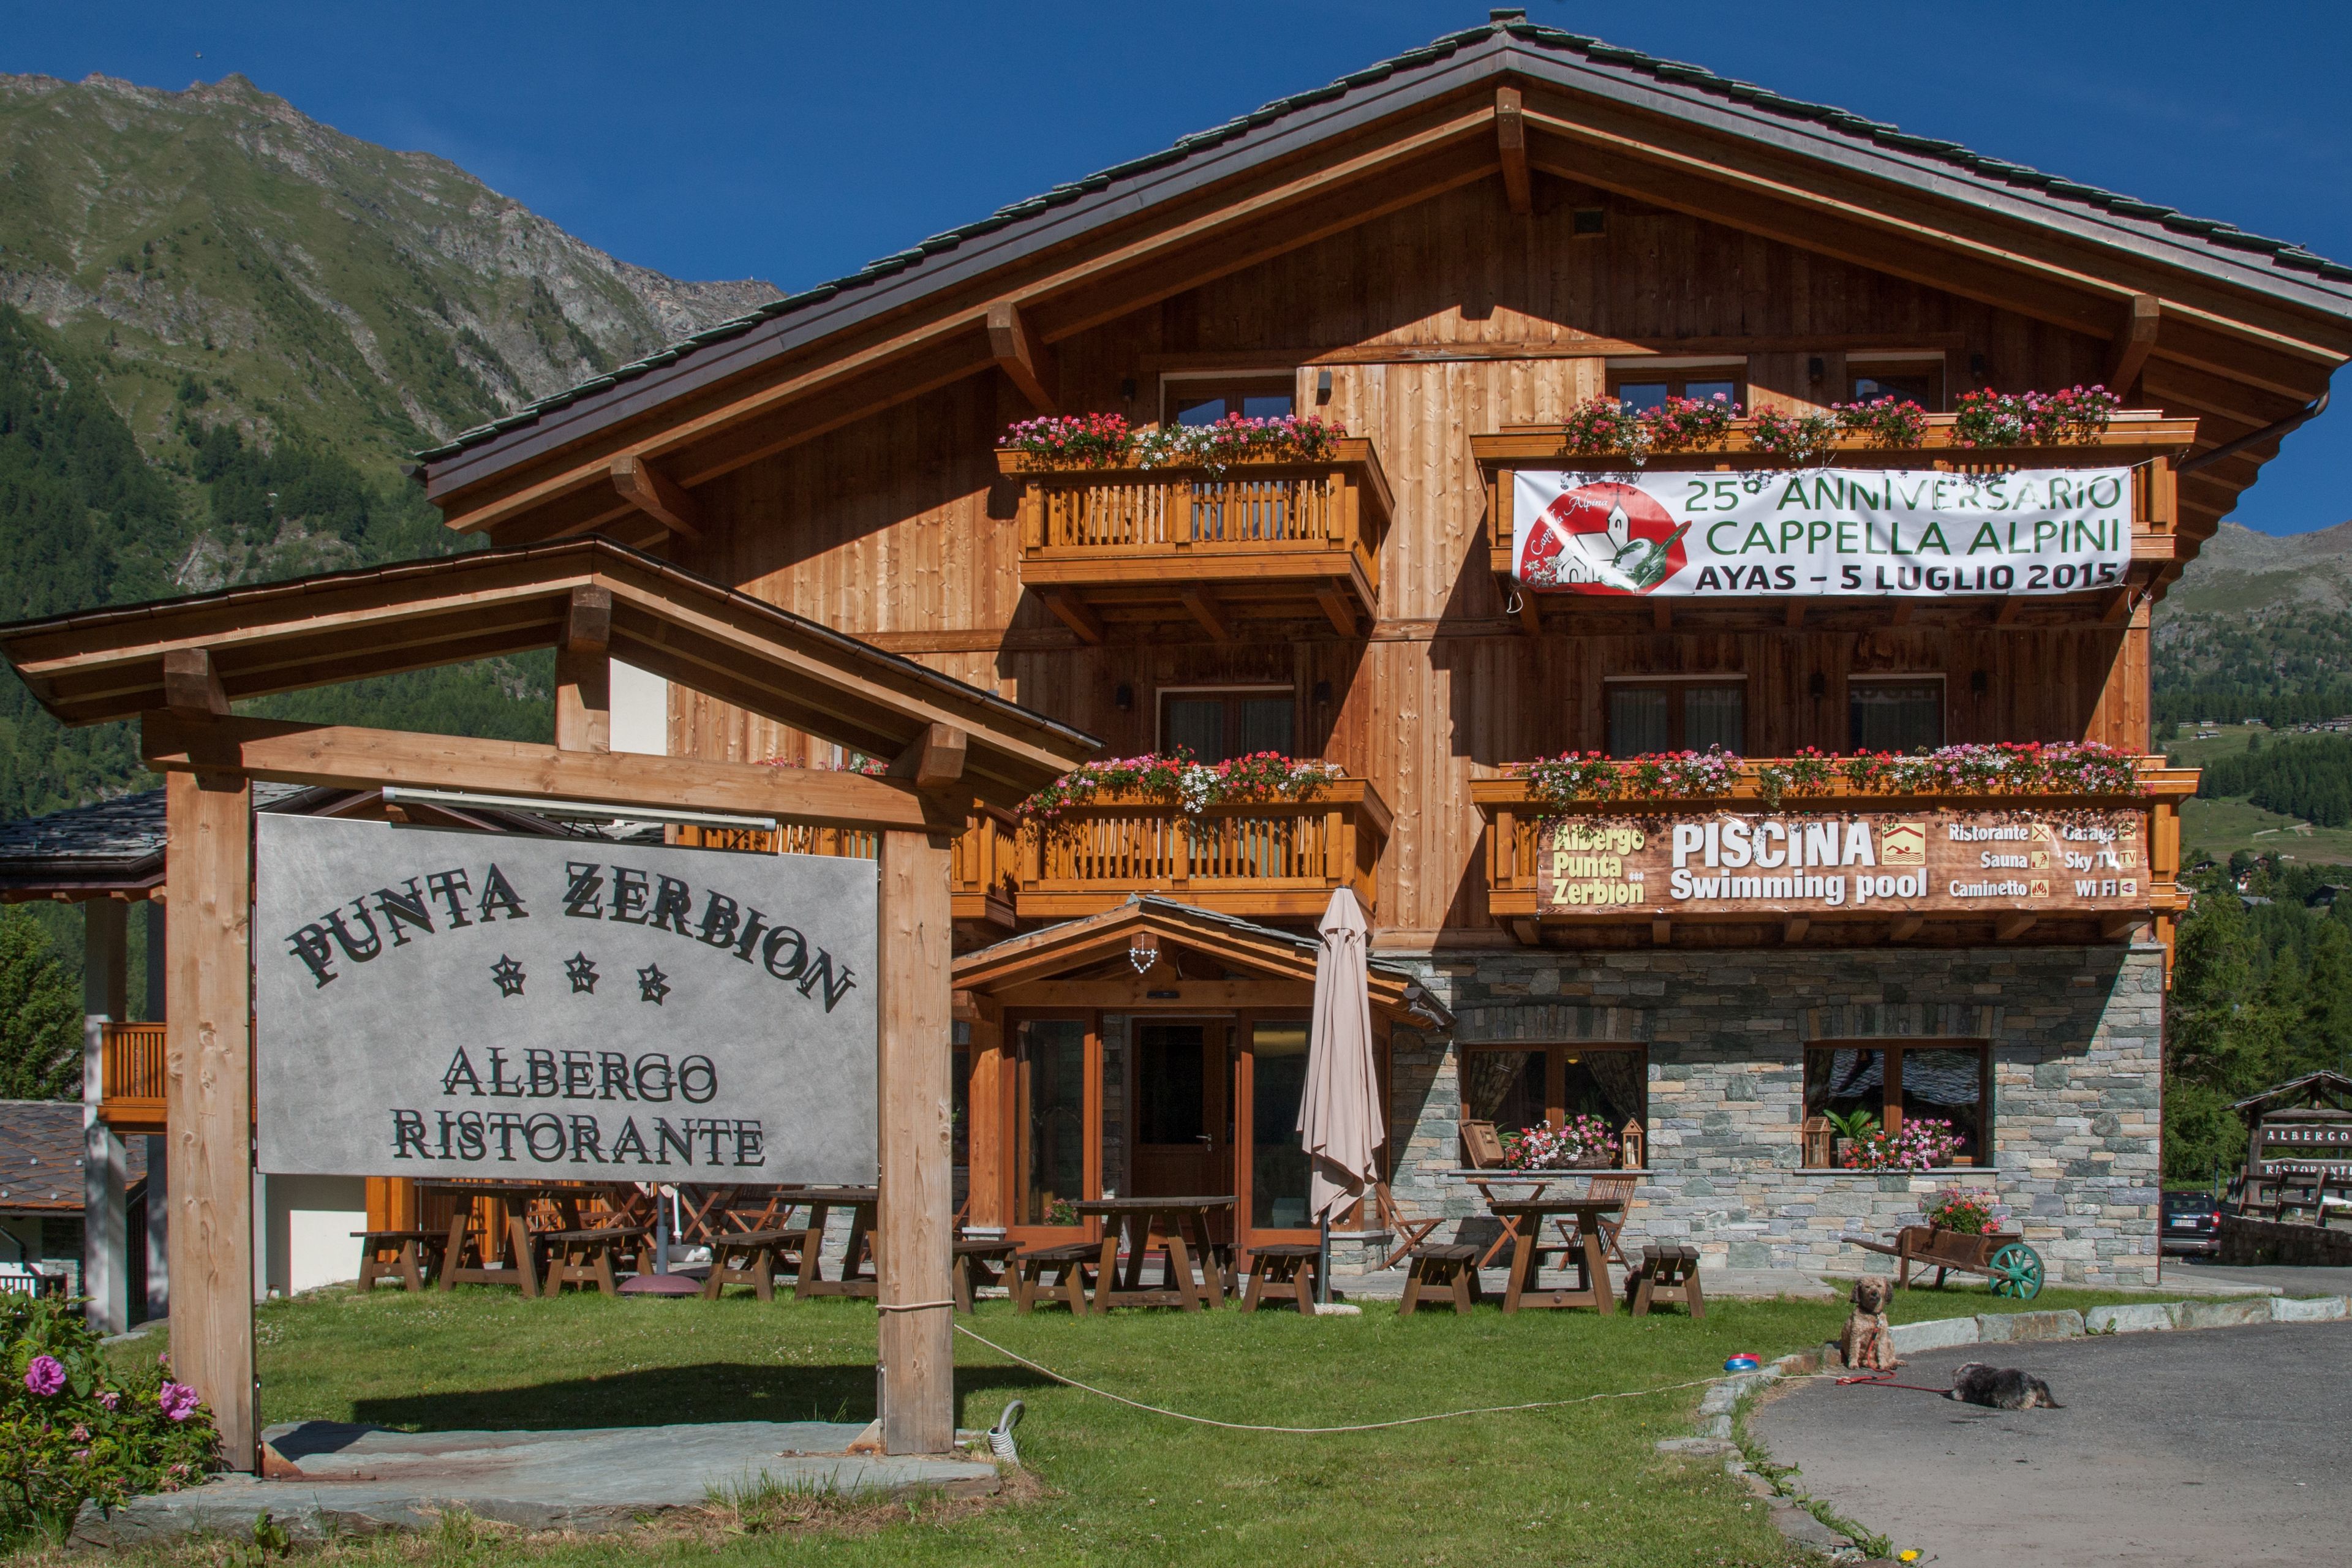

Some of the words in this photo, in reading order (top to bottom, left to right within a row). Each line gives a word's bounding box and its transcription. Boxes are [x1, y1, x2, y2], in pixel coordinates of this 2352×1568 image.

[1776, 475, 2121, 511] ANNIVERSARIO
[1531, 508, 1564, 556] Cappla
[1564, 492, 1608, 516] Alpina
[1706, 521, 1951, 556] CAPPELLA
[1966, 519, 2119, 556] ALPINI
[1695, 565, 1796, 590] AYAS
[1840, 565, 1862, 589] 5
[1875, 564, 2015, 591] LUGLIO
[2027, 562, 2117, 590] 2015
[1553, 824, 1645, 856] Albergo
[1672, 822, 1876, 869] PISCINA
[1949, 823, 2029, 841] Ristorante
[2062, 823, 2117, 845] Garage
[1553, 851, 1623, 878] Punta
[1980, 850, 2028, 869] Sauna
[2065, 851, 2093, 873] Sky
[2096, 851, 2117, 869] TV
[2120, 852, 2136, 863] TV
[1551, 878, 1645, 905] Zerbion
[1670, 867, 1845, 905] Swimming
[1856, 867, 1928, 904] pool
[1949, 879, 2028, 898] Caminetto
[2075, 879, 2097, 897] Wi
[2101, 878, 2117, 897] Fi
[284, 862, 529, 989] PUNTA
[562, 861, 856, 1014] ZERBION
[440, 1045, 718, 1103] ALBERGO
[389, 1108, 766, 1166] RISTORANTE
[2267, 1130, 2350, 1141] ALBERGO
